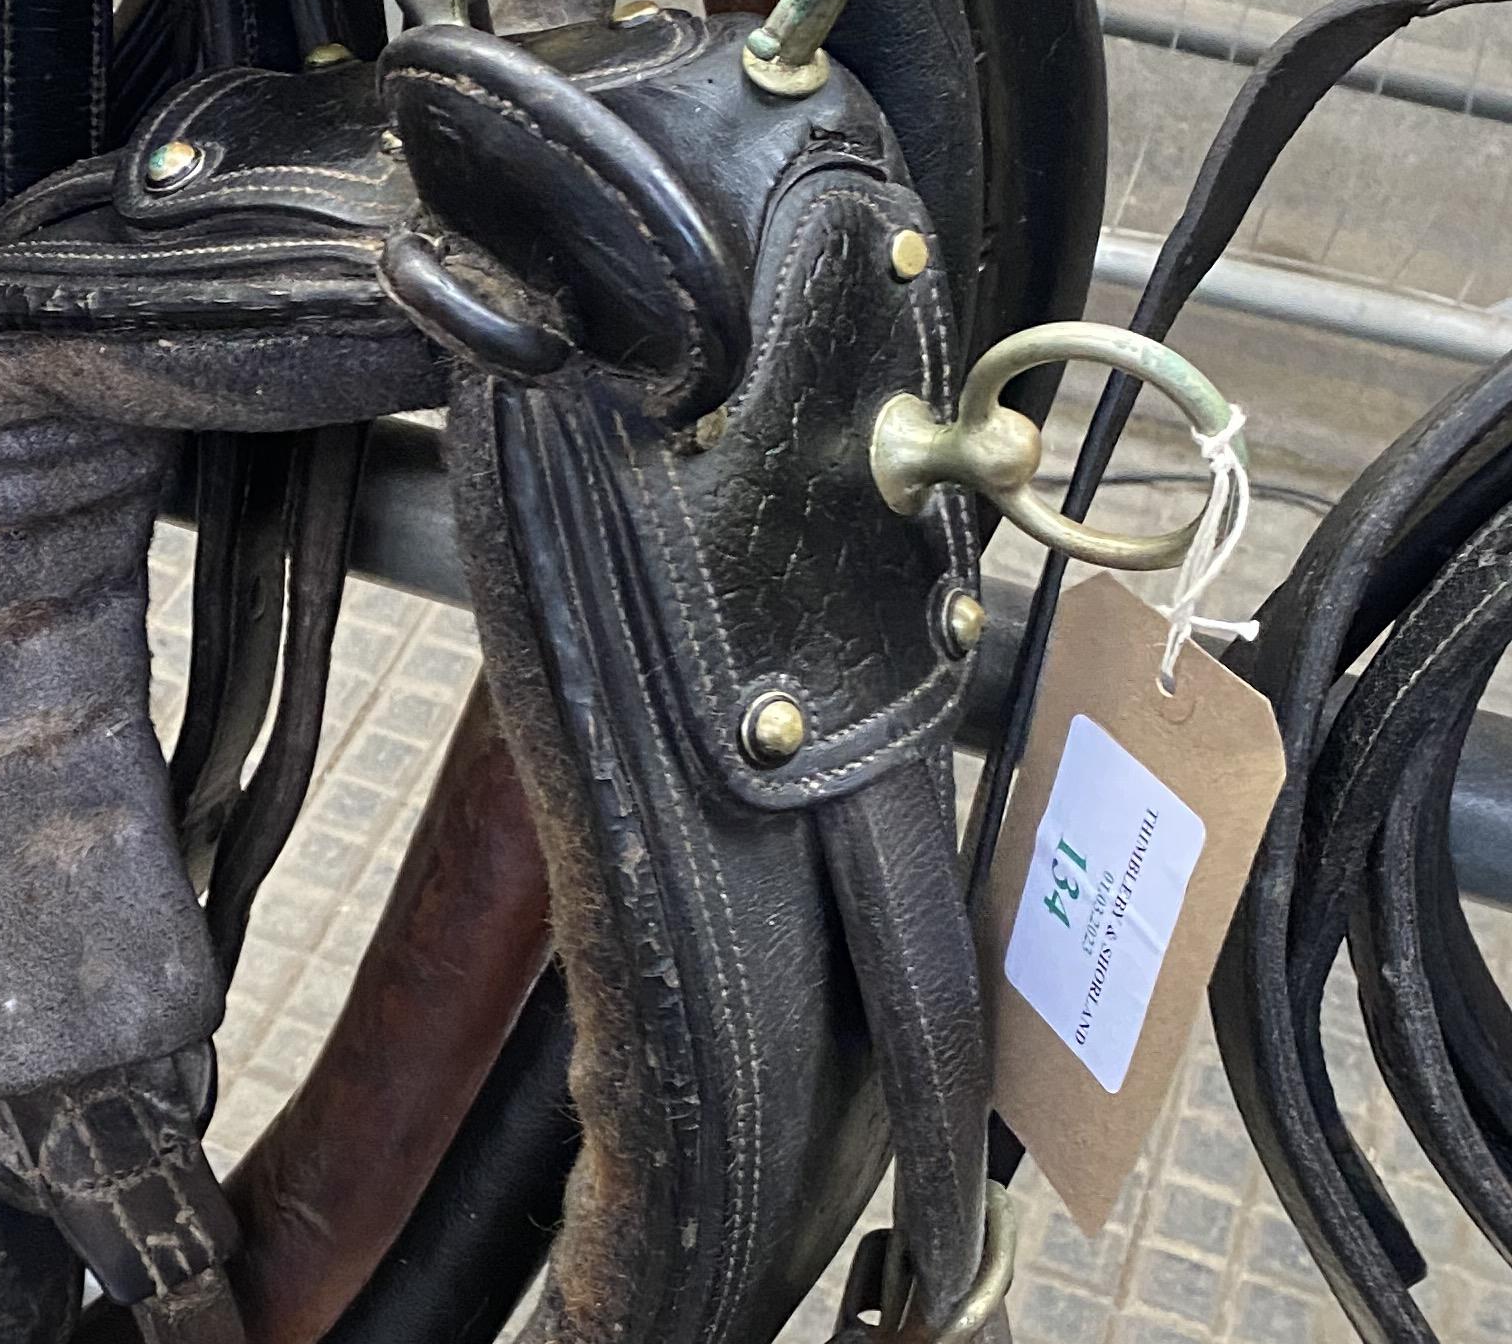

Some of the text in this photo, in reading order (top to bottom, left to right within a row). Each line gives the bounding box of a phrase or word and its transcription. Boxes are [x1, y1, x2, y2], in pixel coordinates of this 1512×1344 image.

[1043, 834, 1088, 928] 134
[1075, 808, 1159, 1046] THIMBLEBY & SHORLAND
[1081, 870, 1115, 956] 01.03.2023
